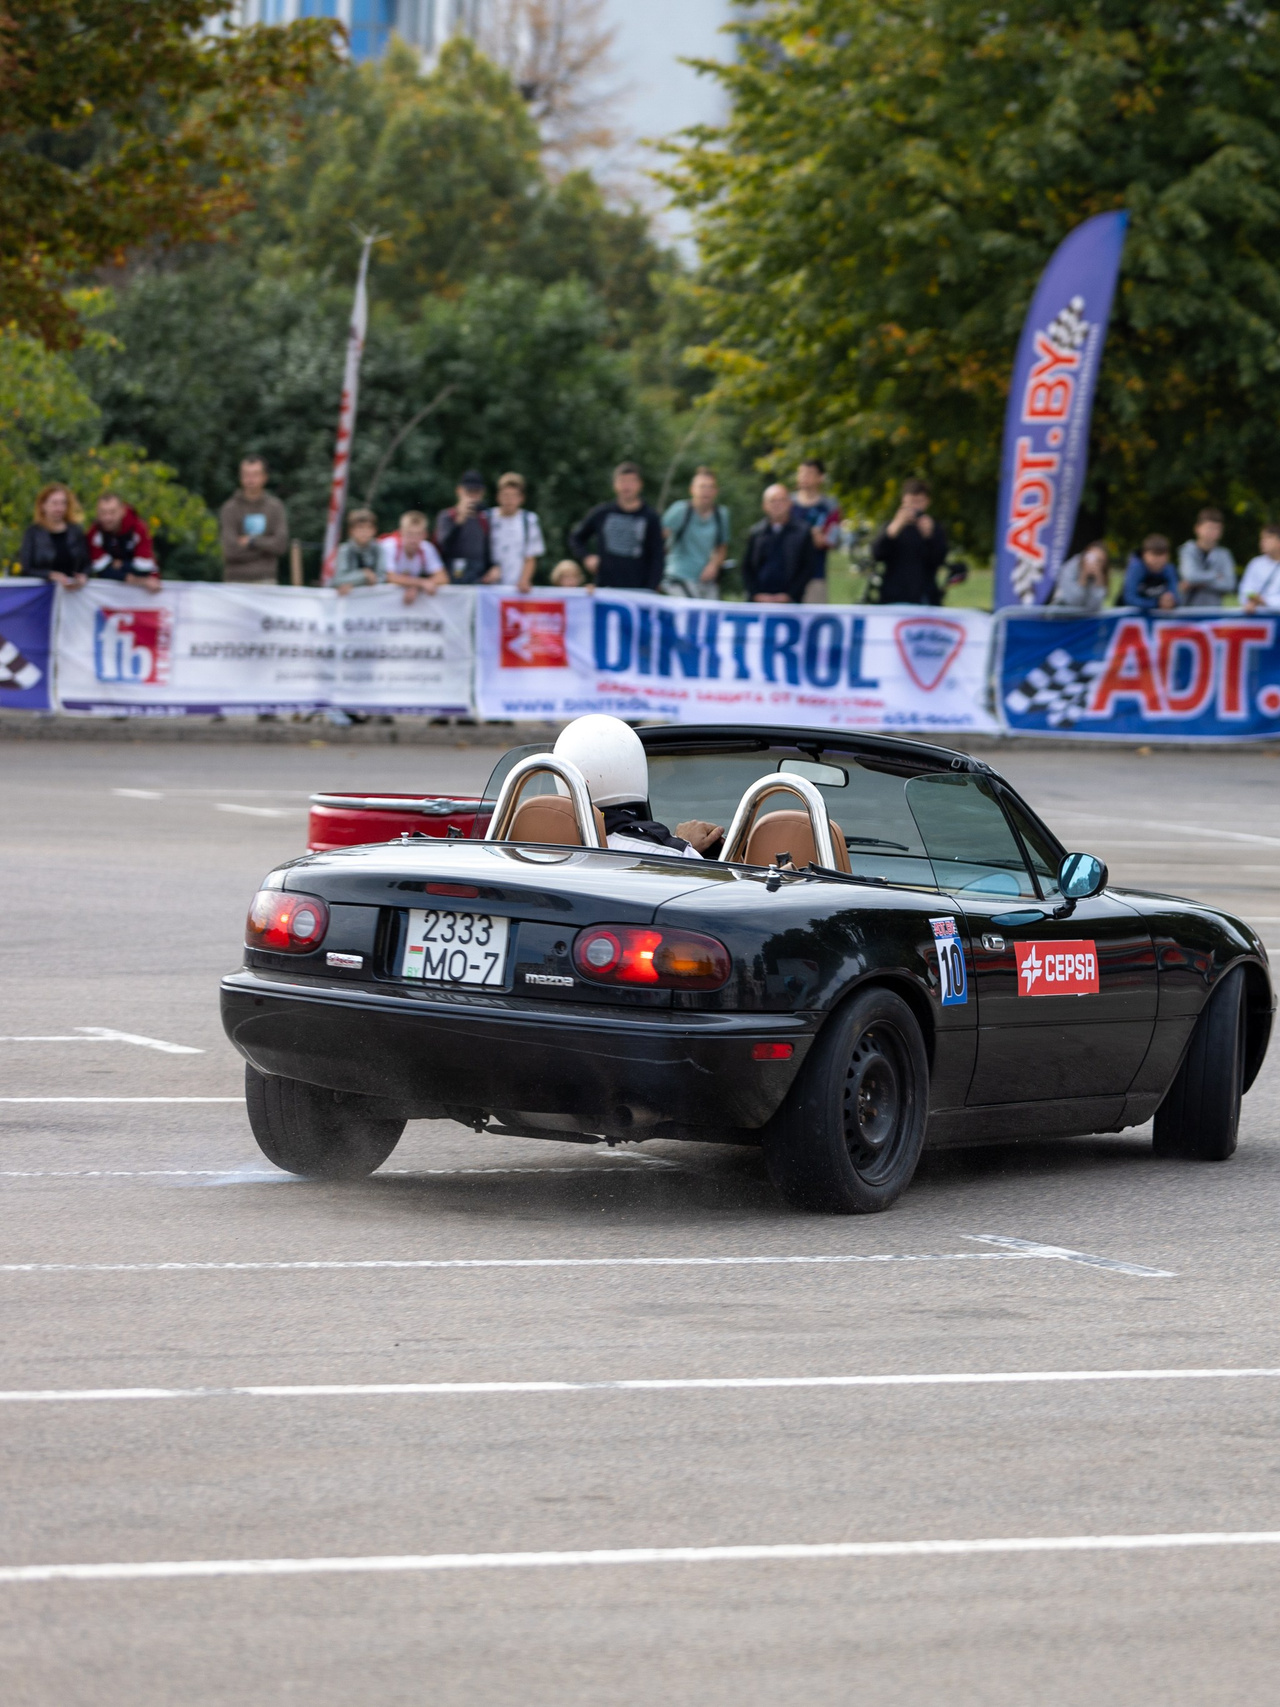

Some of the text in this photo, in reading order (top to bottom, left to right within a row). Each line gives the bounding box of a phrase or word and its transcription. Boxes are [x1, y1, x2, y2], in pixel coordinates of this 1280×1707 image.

[1007, 331, 1080, 561] ADT.BY
[190, 642, 444, 660] КОРПОРАТИВНАЯ СИМВОЛИКА
[593, 602, 880, 690] DINITROL
[423, 910, 493, 946] 2333
[423, 947, 499, 985] MO-7
[940, 943, 965, 998] 10
[1045, 953, 1095, 981] CEPSA
